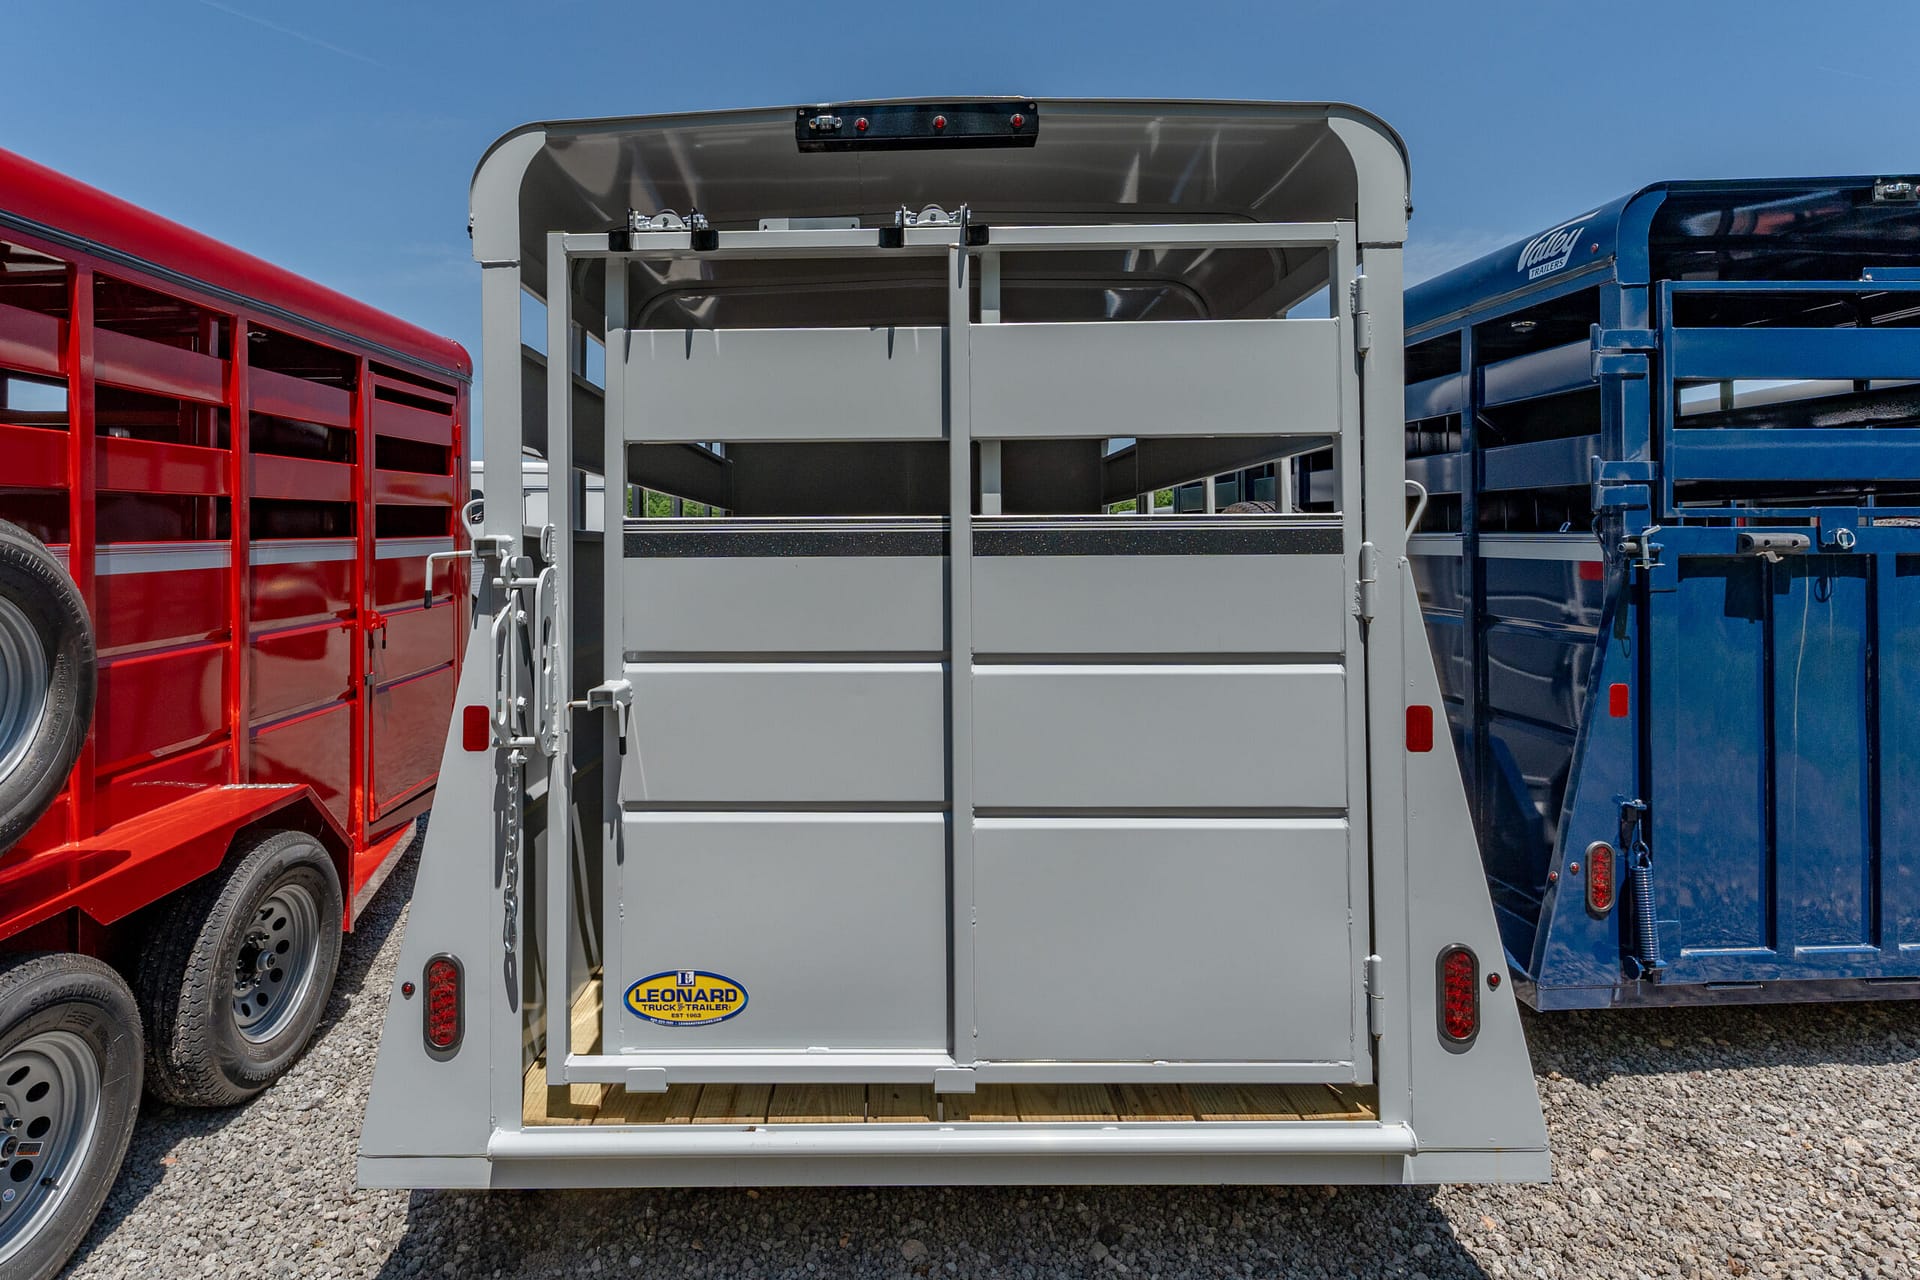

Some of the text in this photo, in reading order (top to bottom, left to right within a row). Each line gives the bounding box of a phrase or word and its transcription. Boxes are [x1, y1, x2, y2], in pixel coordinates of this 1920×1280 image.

[1517, 226, 1586, 273] Valley
[1530, 259, 1565, 278] TRAILERS
[635, 988, 737, 1003] LEONARD
[642, 1003, 676, 1011] TRUCK
[685, 1003, 729, 1011] TRAILER
